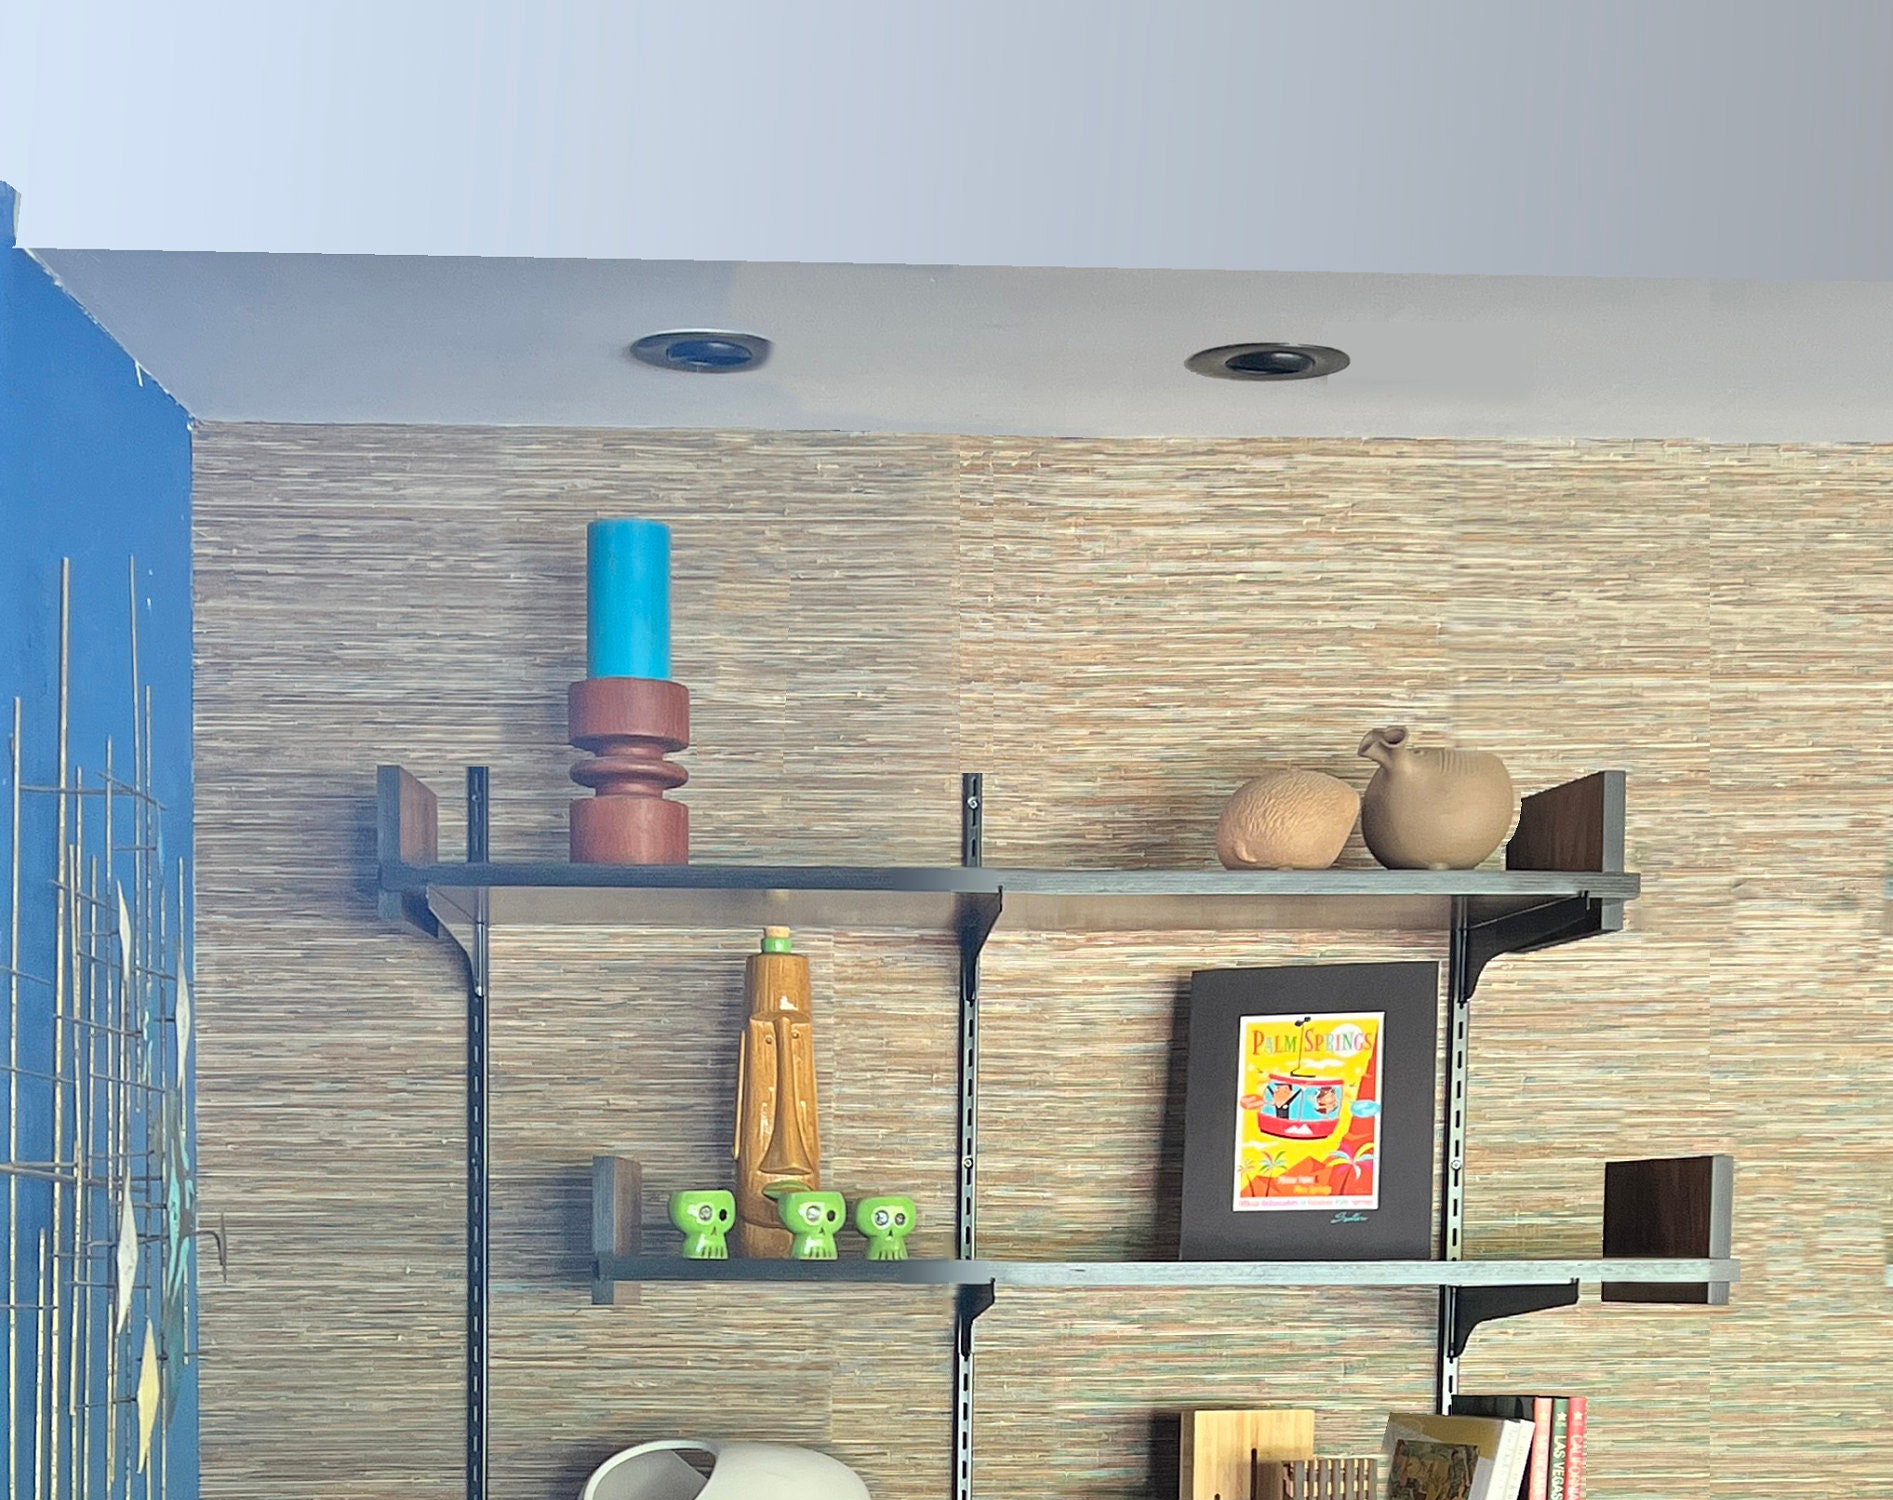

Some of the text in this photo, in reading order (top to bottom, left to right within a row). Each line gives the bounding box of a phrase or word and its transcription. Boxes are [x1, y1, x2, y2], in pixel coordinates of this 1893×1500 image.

[1252, 1028, 1373, 1055] PALM SPRINGS
[1551, 1435, 1567, 1500] LAS VEGAS
[1567, 1435, 1583, 1500] CALIFORNIA
